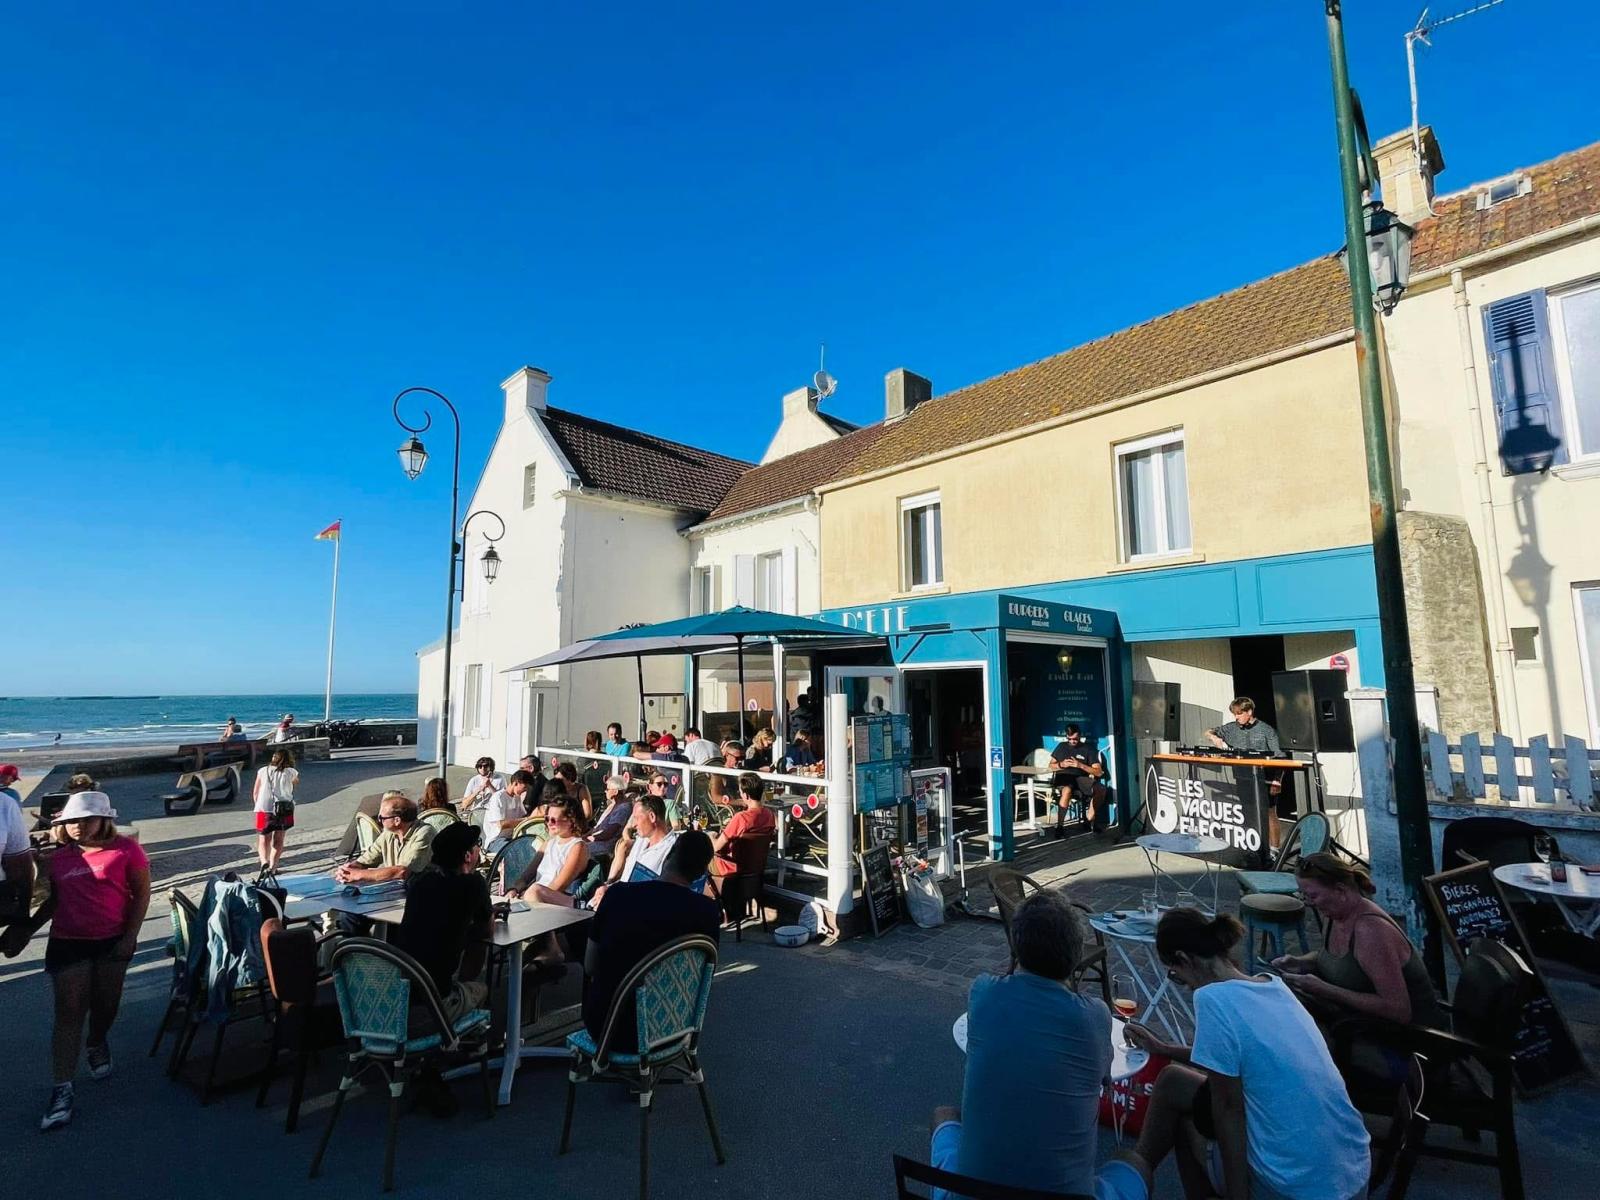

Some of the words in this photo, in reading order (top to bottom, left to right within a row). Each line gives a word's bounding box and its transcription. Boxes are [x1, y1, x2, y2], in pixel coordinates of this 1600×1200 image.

[1008, 603, 1049, 619] BURGERS
[1064, 610, 1092, 624] GLACES
[1178, 778, 1204, 798] LES
[1179, 798, 1244, 825] VAGUES
[1180, 816, 1261, 852] ELECTRO
